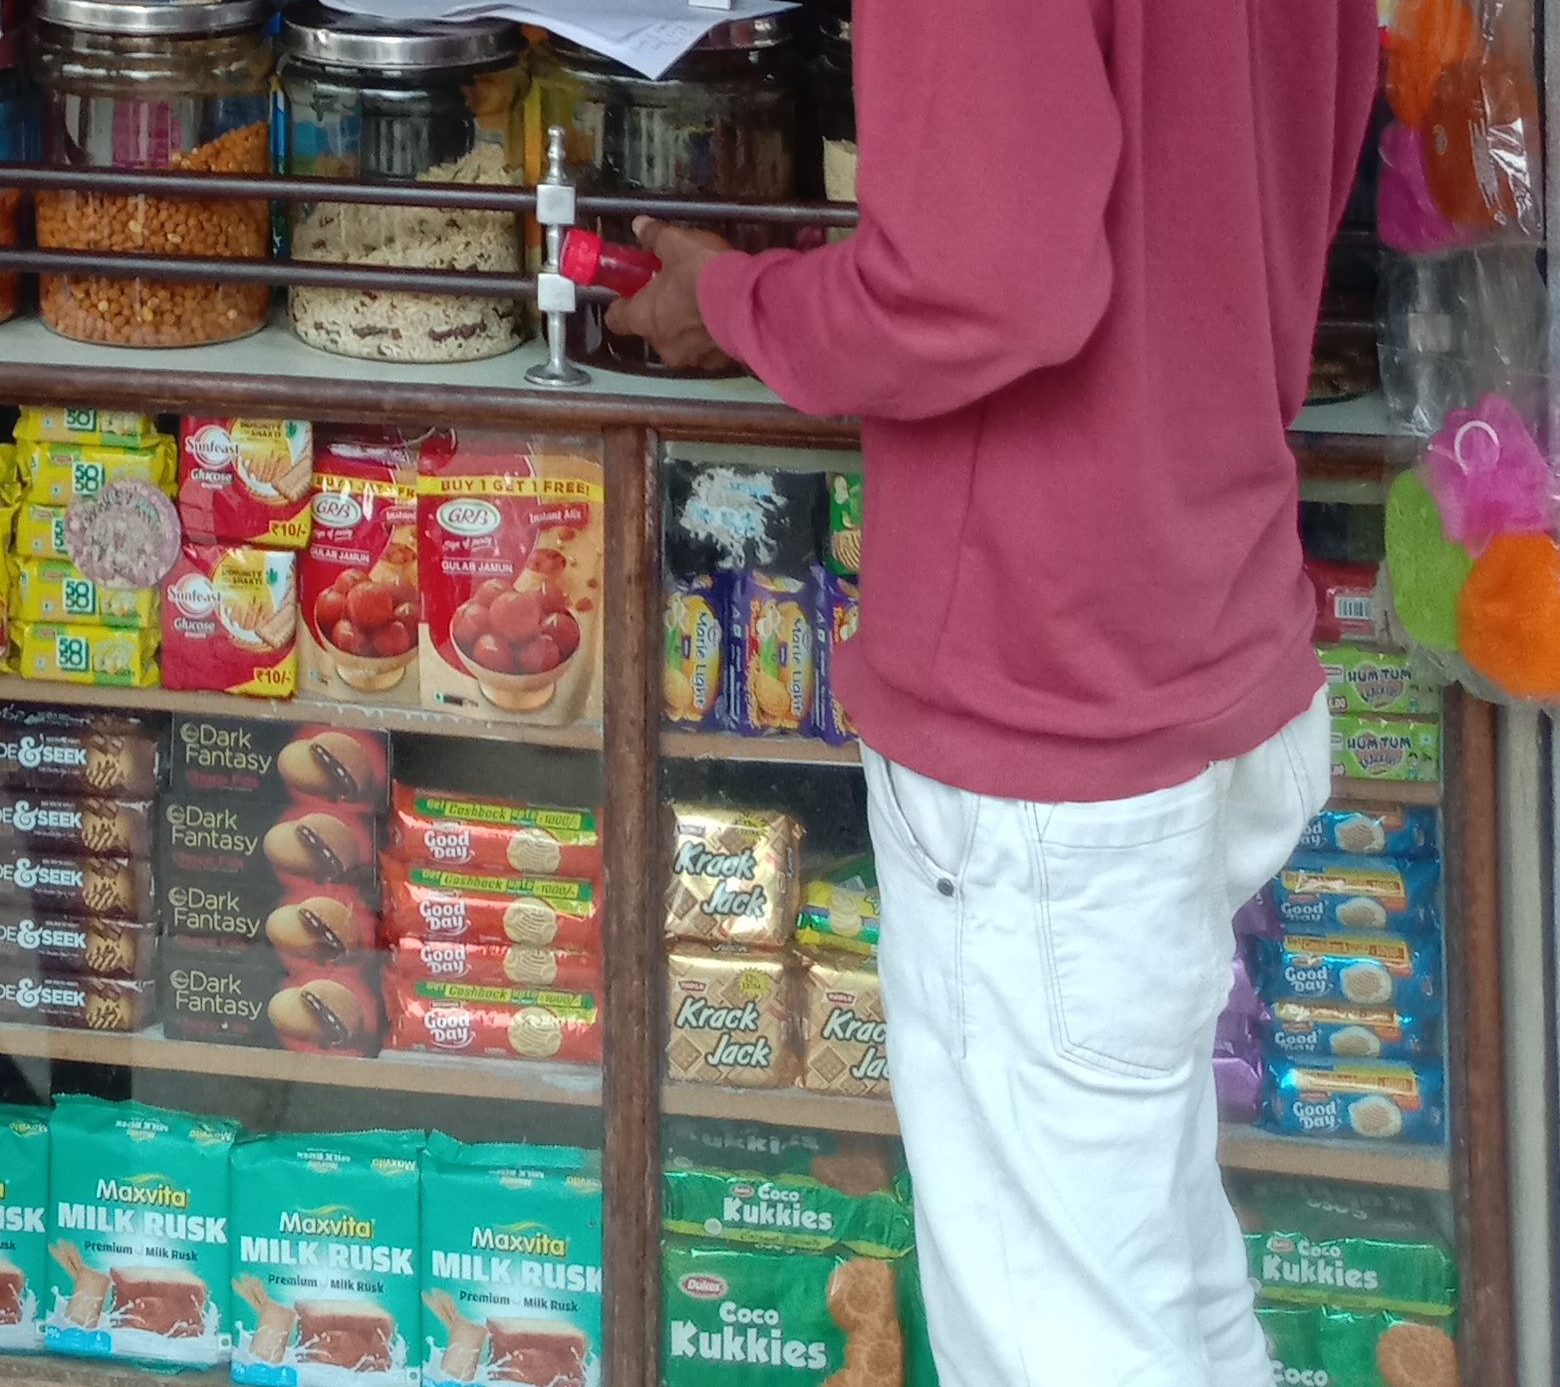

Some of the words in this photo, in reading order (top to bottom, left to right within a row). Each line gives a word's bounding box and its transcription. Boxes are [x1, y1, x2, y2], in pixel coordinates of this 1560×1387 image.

[185, 437, 240, 456] Sunfeast
[190, 470, 233, 484] Glucose
[440, 479, 473, 491] BUY
[480, 479, 487, 491] 1
[493, 479, 525, 493] GET
[532, 480, 538, 492] 1
[543, 480, 590, 495] FREE!
[315, 500, 351, 518] GRB
[448, 506, 489, 525] GRB
[528, 510, 561, 525] Instant
[562, 508, 582, 521] Mix
[270, 522, 307, 538] ₹10/-
[441, 559, 476, 572] GULAB
[477, 561, 513, 574] JAMUN
[167, 585, 222, 604] Sunfeast
[173, 618, 216, 632] Glucose
[695, 611, 709, 660] Marie
[255, 669, 291, 685] ₹10/-
[1346, 669, 1380, 682] HUM
[1382, 667, 1412, 680] TUM
[693, 663, 708, 709] Light
[200, 724, 252, 748] Dark
[1346, 737, 1380, 750] HUM
[1382, 736, 1412, 750] TUM
[185, 744, 272, 774] Fantasy
[186, 806, 238, 829] Dark
[171, 825, 258, 855] Fantasy
[424, 830, 470, 846] Good
[430, 844, 468, 860] Day
[188, 889, 240, 912] Dark
[419, 900, 465, 917] Good
[701, 879, 767, 918] Jack
[174, 908, 261, 938] Fantasy
[426, 914, 465, 930] Day
[420, 946, 466, 962] Good
[427, 959, 465, 974] Day
[190, 971, 242, 994] Dark
[175, 991, 263, 1020] Fantasy
[675, 996, 760, 1031] Krack
[424, 1012, 470, 1028] Good
[705, 1030, 771, 1068] Jack
[96, 1178, 188, 1208] Maxvita
[757, 1182, 800, 1202] Coco
[57, 1202, 135, 1235] MILK
[143, 1210, 229, 1244] RUSK
[723, 1196, 833, 1230] Kukkies
[279, 1211, 373, 1239] Maxvita
[84, 1240, 133, 1256] Premium
[145, 1246, 169, 1259] Milk
[171, 1248, 199, 1262] Rusk
[471, 1226, 567, 1256] Maxvita
[1297, 1239, 1341, 1258] Coco
[240, 1235, 320, 1267] MILK
[328, 1243, 415, 1276] RUSK
[432, 1250, 513, 1280] MILK
[521, 1259, 602, 1294] RUSK
[1261, 1253, 1379, 1291] Kukkies
[268, 1274, 318, 1289] Premium
[330, 1278, 355, 1291] Milk
[357, 1280, 384, 1294] Rusk
[687, 1279, 721, 1293] Dukes
[459, 1290, 511, 1306] Premium
[719, 1300, 780, 1326] Coco
[670, 1319, 827, 1369] Kukkies
